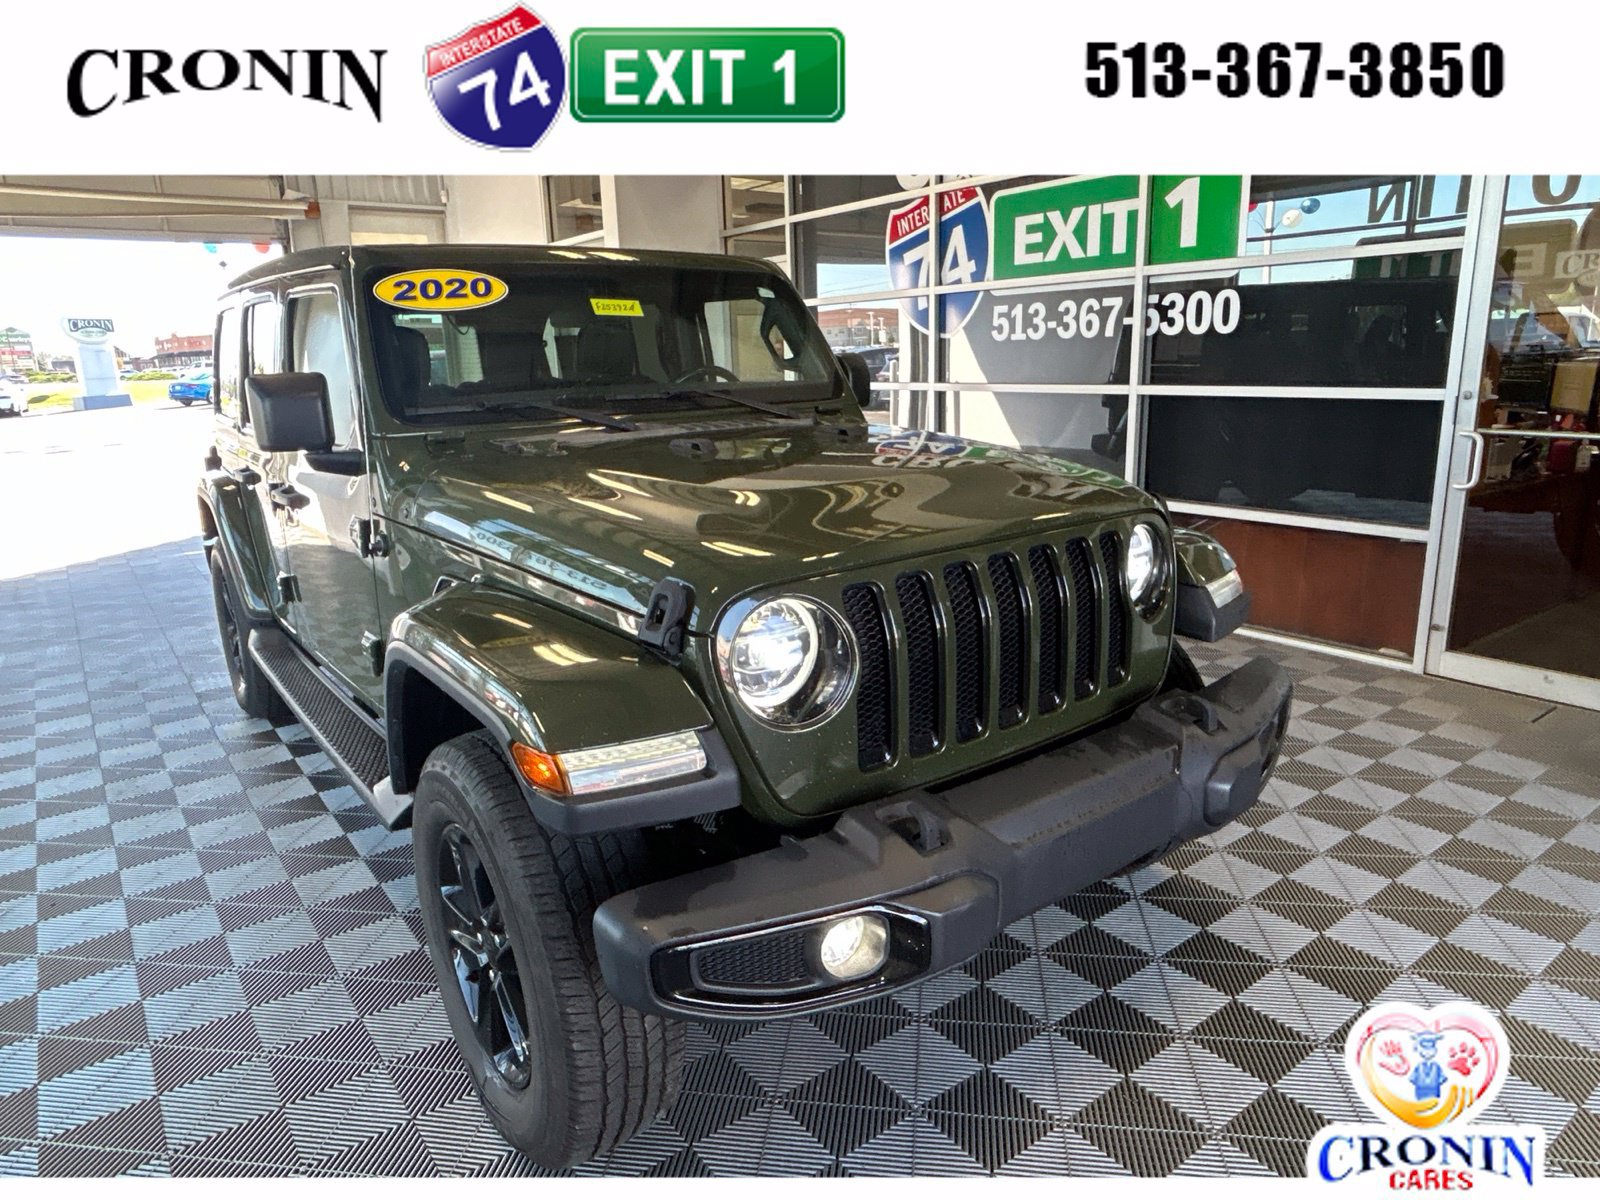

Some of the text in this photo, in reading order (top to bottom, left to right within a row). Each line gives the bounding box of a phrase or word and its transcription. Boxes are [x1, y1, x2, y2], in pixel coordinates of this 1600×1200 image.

[1014, 177, 1201, 266] EXIT 1
[393, 278, 493, 301] 2020
[903, 224, 977, 311] 74
[70, 319, 113, 332] CRONIN
[991, 289, 1241, 342] 513-367-5300
